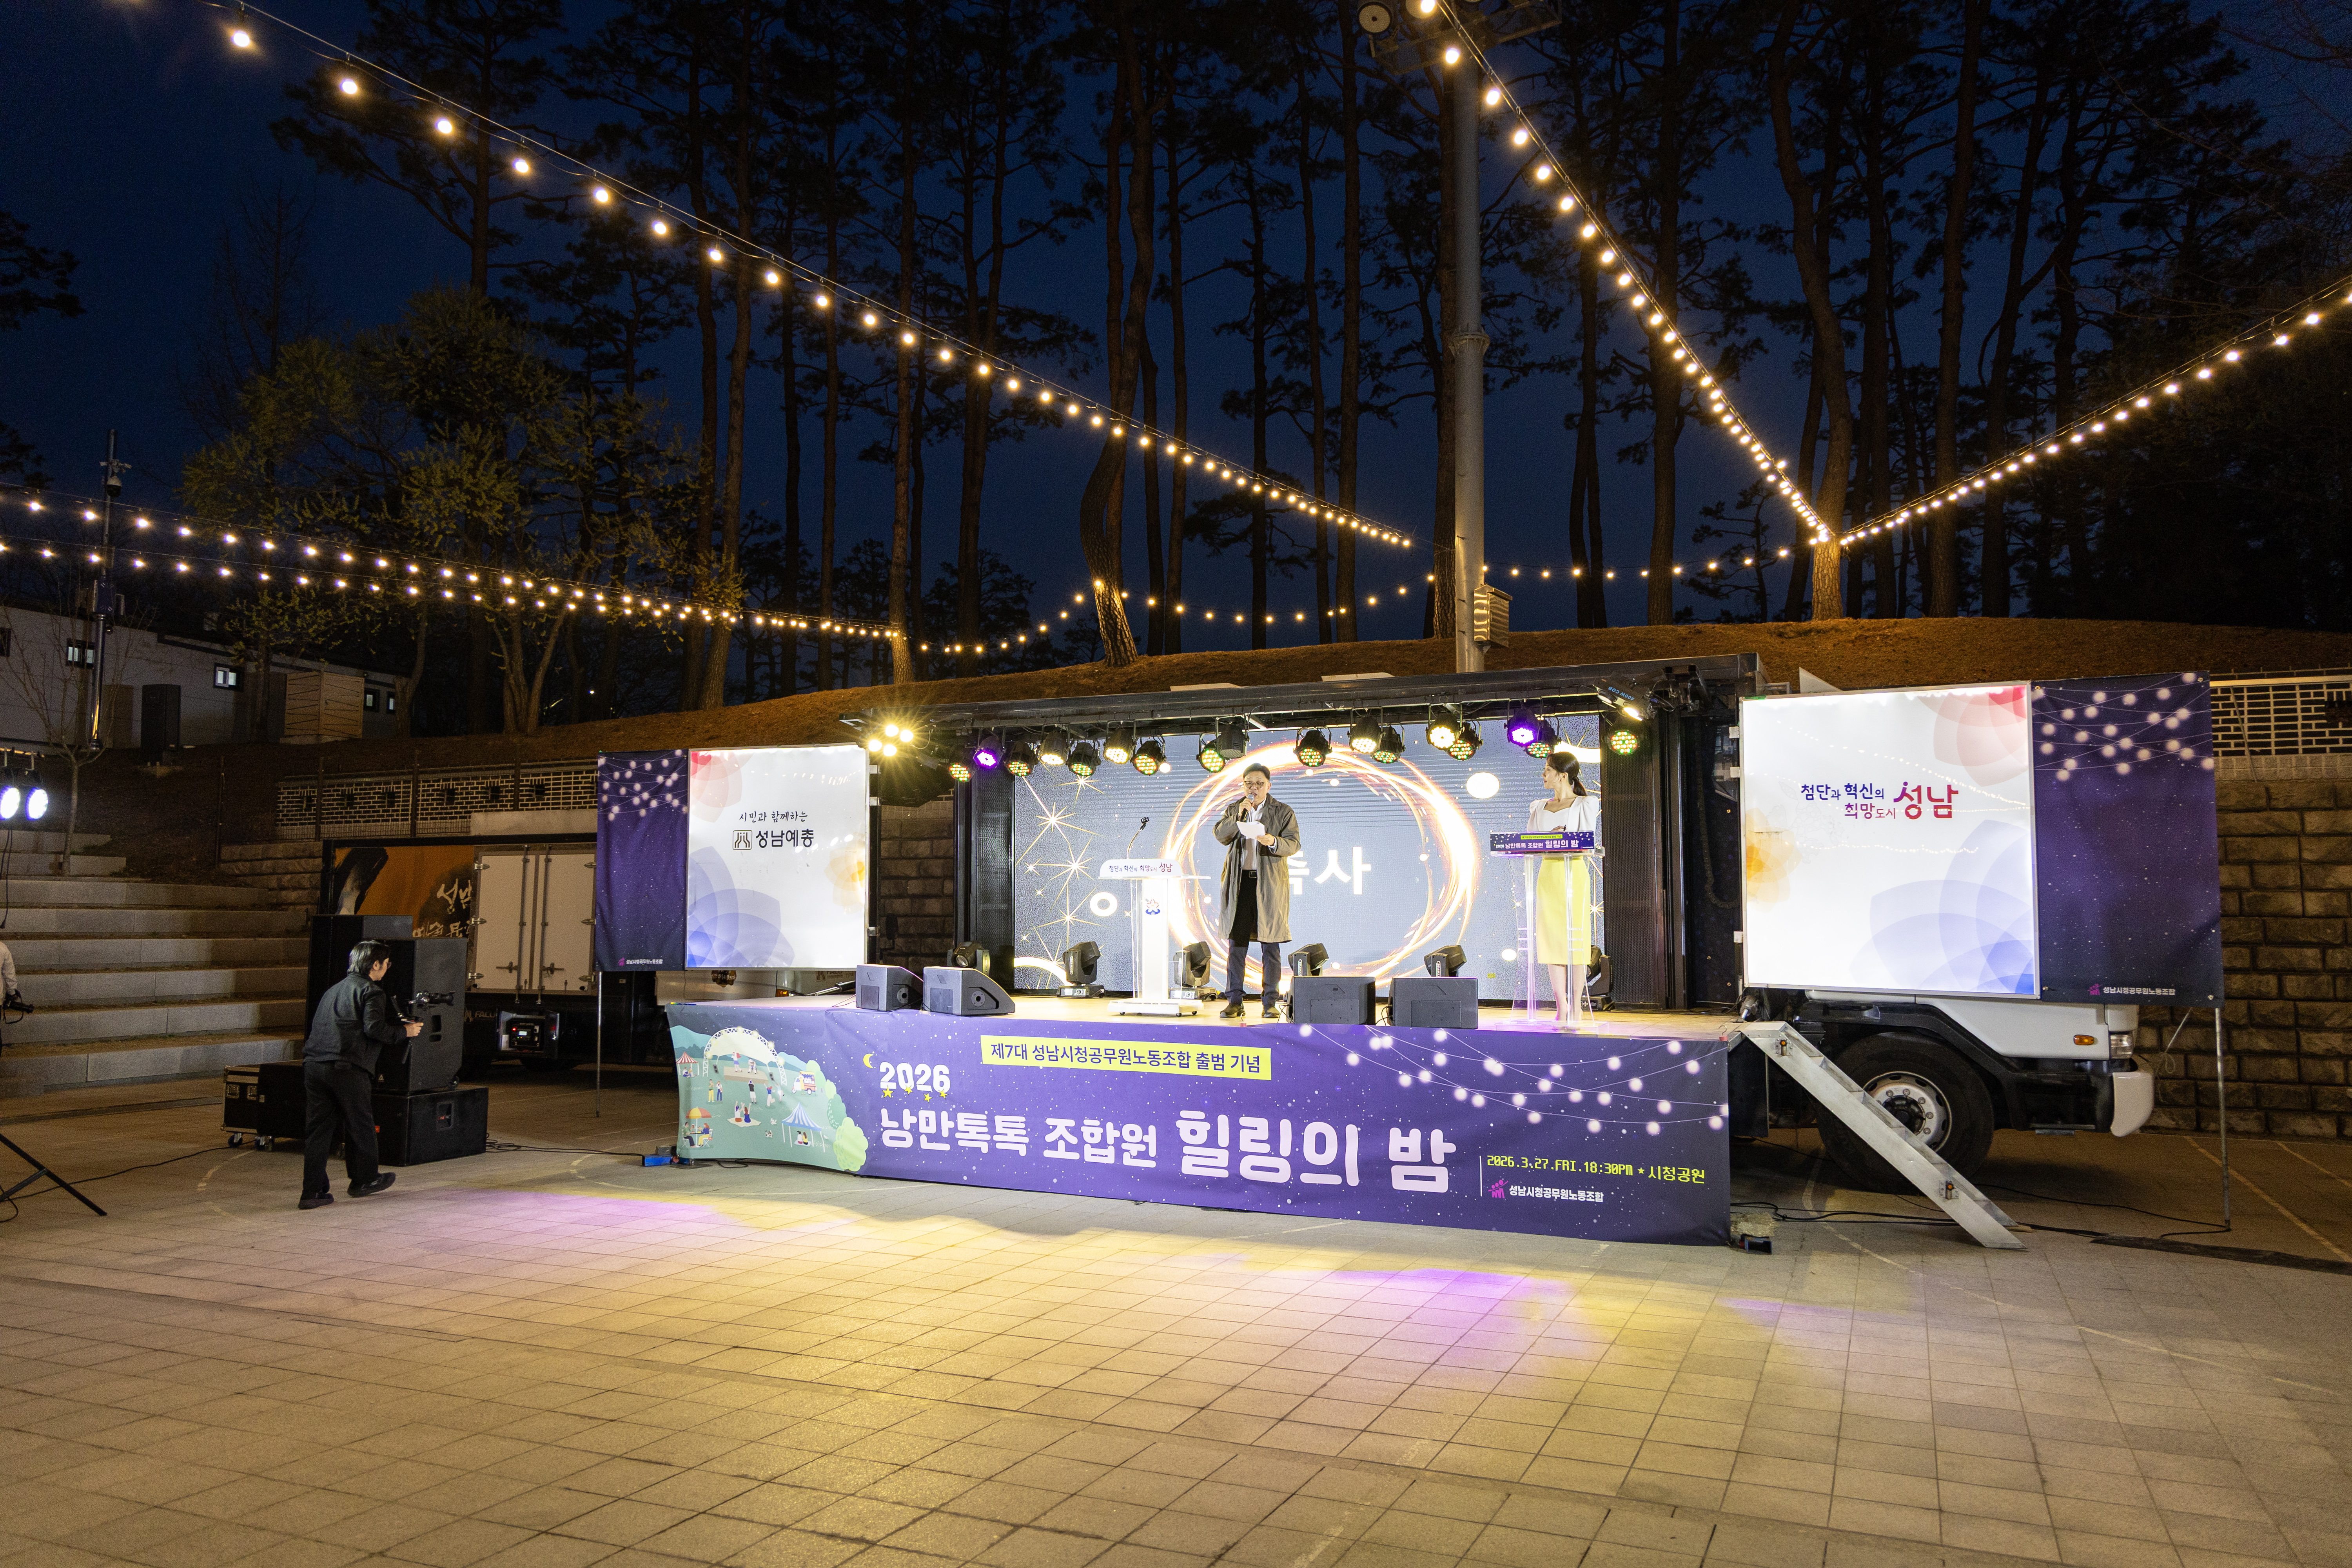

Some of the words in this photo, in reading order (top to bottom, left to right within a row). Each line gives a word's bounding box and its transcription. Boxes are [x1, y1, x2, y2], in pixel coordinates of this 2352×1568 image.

[1619, 692, 1635, 701] 400W
[1801, 784, 1841, 800] 첨단과
[1844, 783, 1884, 800] 혁신의
[1893, 781, 1959, 820] 성남
[739, 811, 767, 823] 시민과
[771, 811, 808, 823] 함께하는
[1844, 802, 1896, 819] 희망도시
[755, 828, 814, 848] 성남예총
[1545, 840, 1568, 848] 힐링의
[1159, 862, 1173, 872] 성남
[2103, 987, 2175, 995] 성남시청공무원노동조합
[991, 1043, 1027, 1060] 제7대
[1032, 1045, 1191, 1069] 성남시청공무원노동조합
[1196, 1052, 1225, 1071] 출범
[1230, 1054, 1260, 1073] 기념
[879, 1062, 951, 1093] 2026
[881, 1108, 1030, 1157] 낭만톡톡
[1043, 1117, 1157, 1169] 조합원
[1176, 1110, 1359, 1187] 힐링의
[1388, 1127, 1456, 1193] 밤
[1648, 1165, 1705, 1184] 시청공원
[1509, 1185, 1604, 1203] 성남시청공무원노동조합
